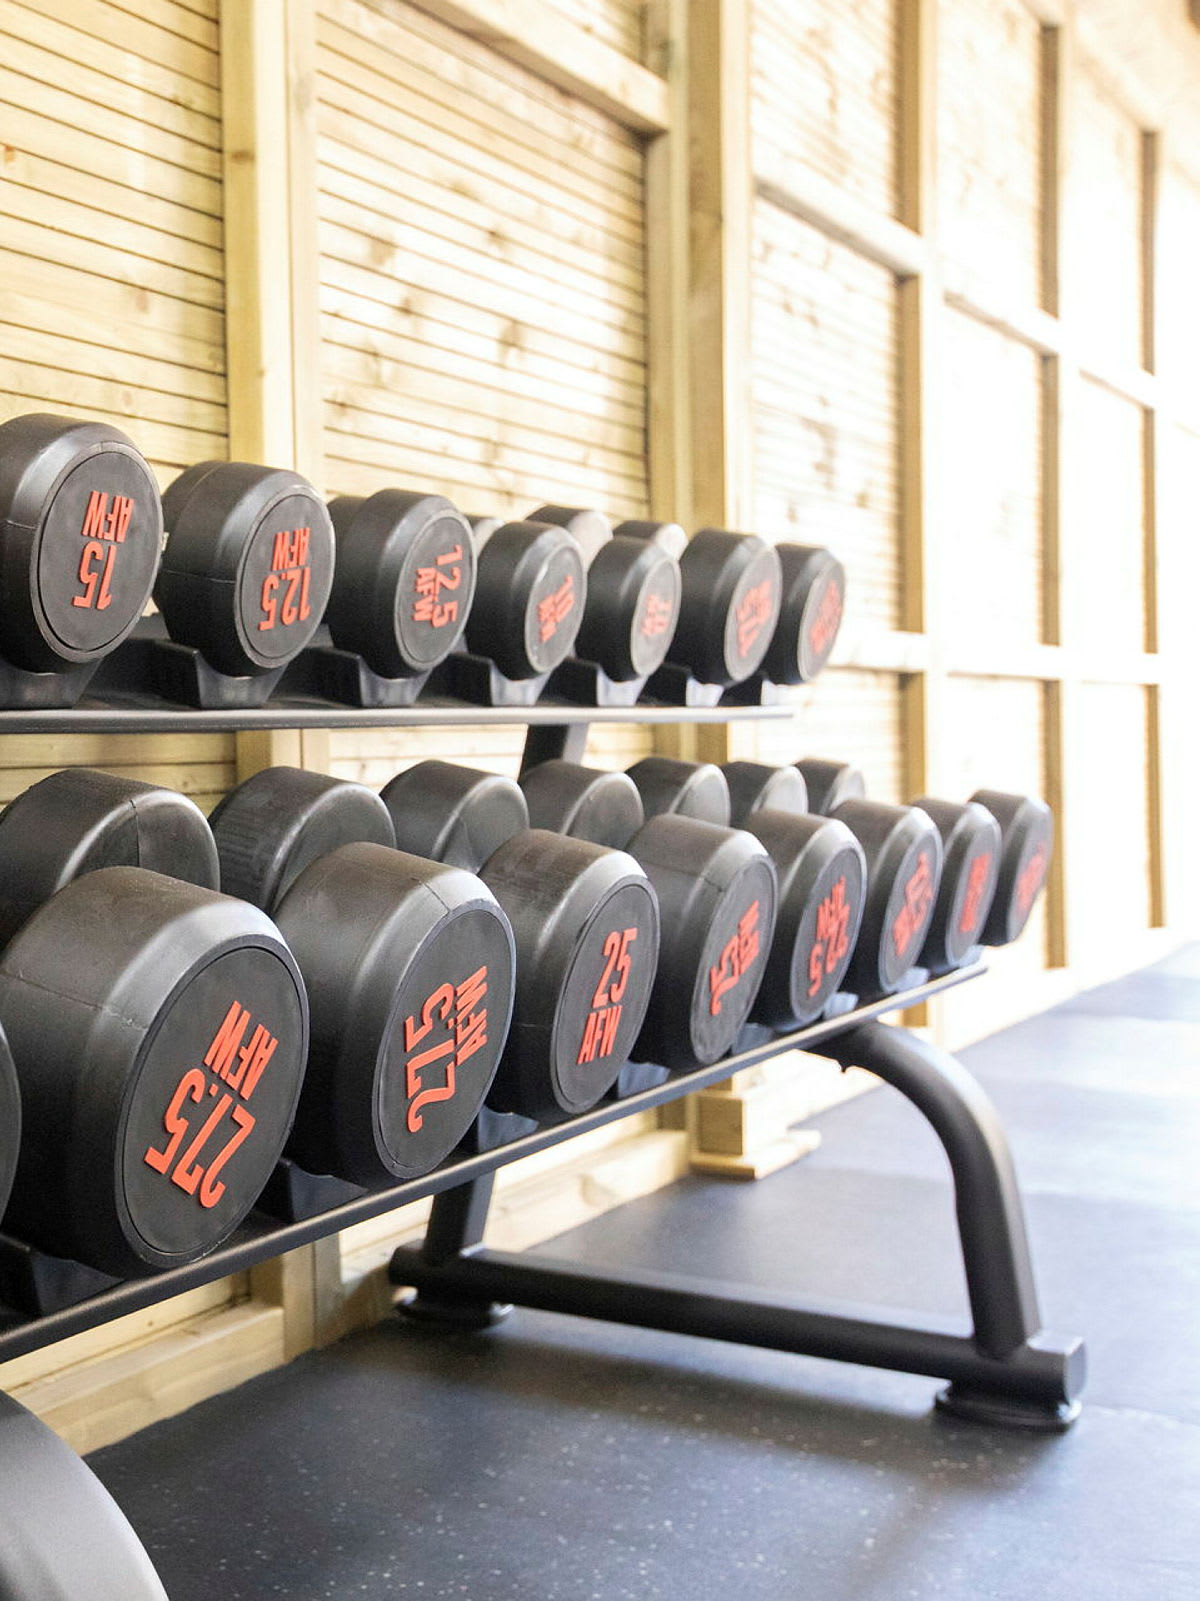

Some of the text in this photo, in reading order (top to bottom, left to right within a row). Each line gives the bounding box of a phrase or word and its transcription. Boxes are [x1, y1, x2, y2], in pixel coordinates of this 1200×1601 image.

[81, 490, 135, 543] AFW
[271, 527, 311, 572] AFW
[71, 541, 117, 610] 15
[258, 566, 311, 631] 12.5
[412, 567, 437, 621] AFW
[592, 927, 638, 1009] 25
[203, 1000, 279, 1101] AFW
[456, 966, 488, 1066] AFW
[576, 1005, 622, 1065] AFW
[405, 983, 456, 1133] 27.5
[144, 1069, 256, 1209] 27.5
